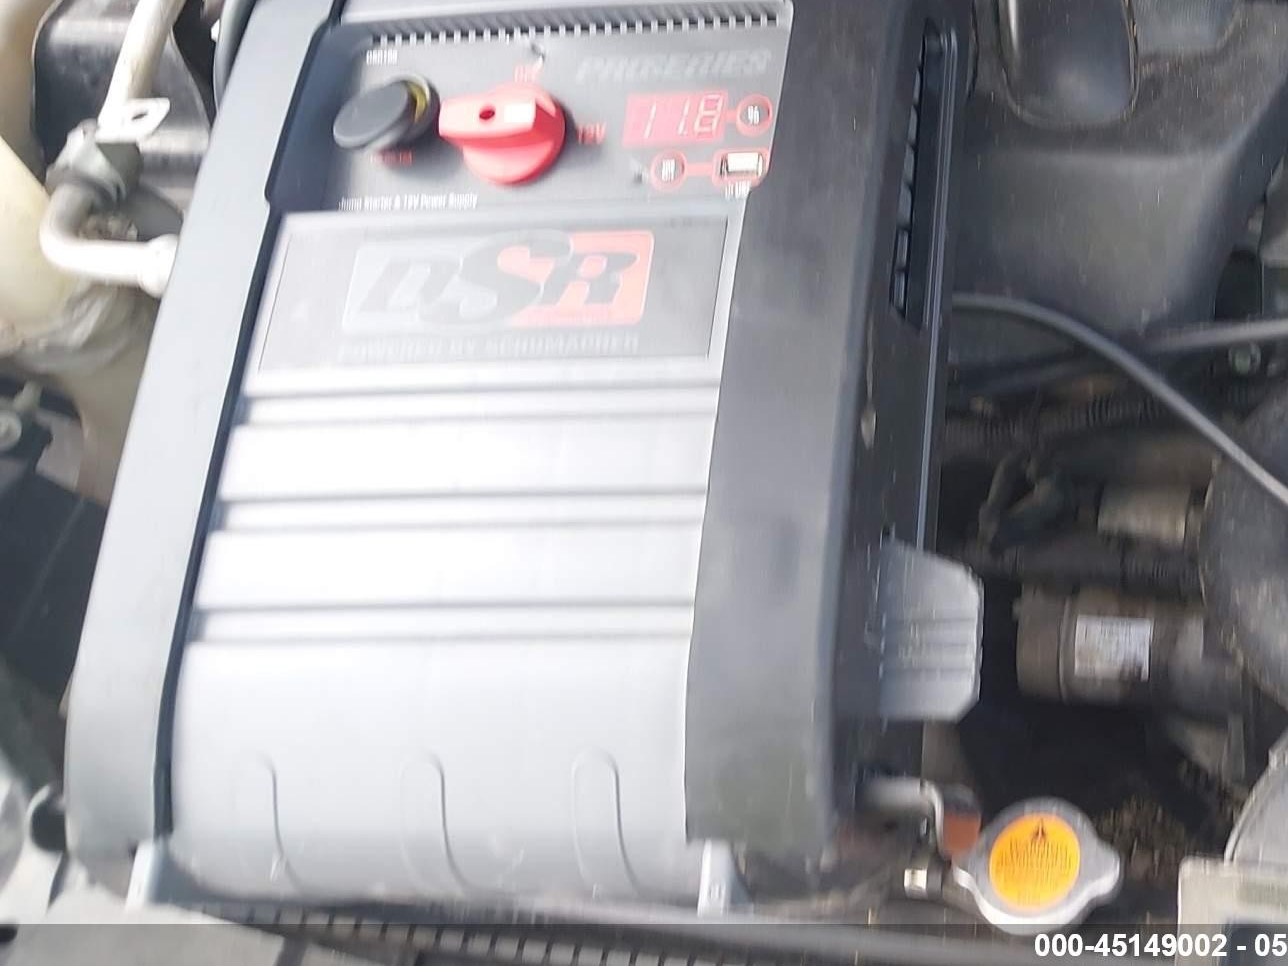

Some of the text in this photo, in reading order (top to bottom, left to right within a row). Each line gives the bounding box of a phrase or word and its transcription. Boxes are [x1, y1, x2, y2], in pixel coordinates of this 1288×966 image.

[420, 193, 447, 210] Power
[448, 192, 478, 211] Supply
[356, 230, 640, 325] DSR
